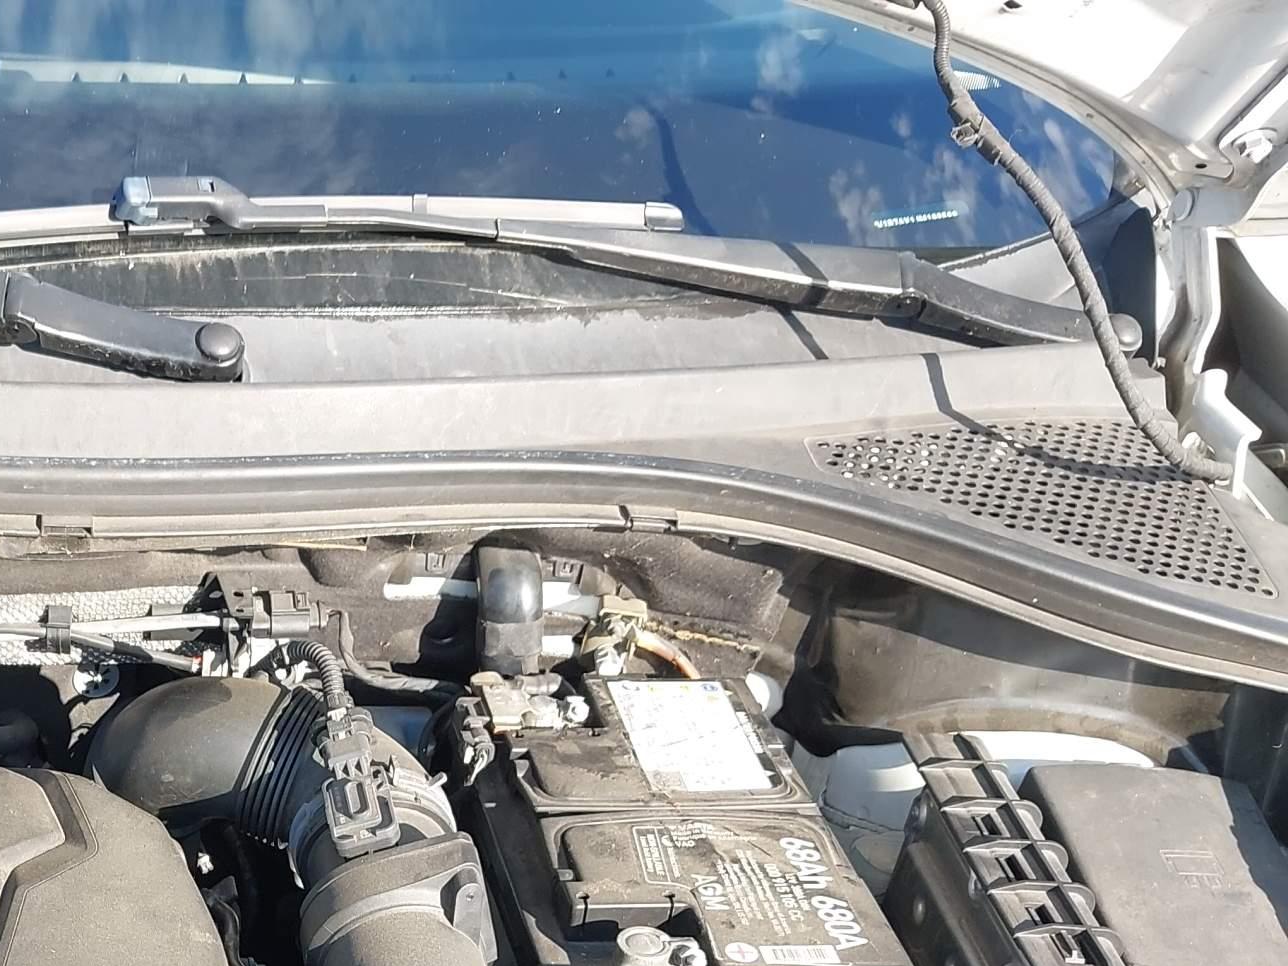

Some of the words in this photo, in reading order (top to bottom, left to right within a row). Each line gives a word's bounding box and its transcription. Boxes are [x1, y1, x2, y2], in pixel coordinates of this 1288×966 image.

[691, 873, 730, 911] AGM
[772, 878, 790, 893] 915
[779, 837, 833, 889] 68Ah
[811, 895, 869, 950] 680A
